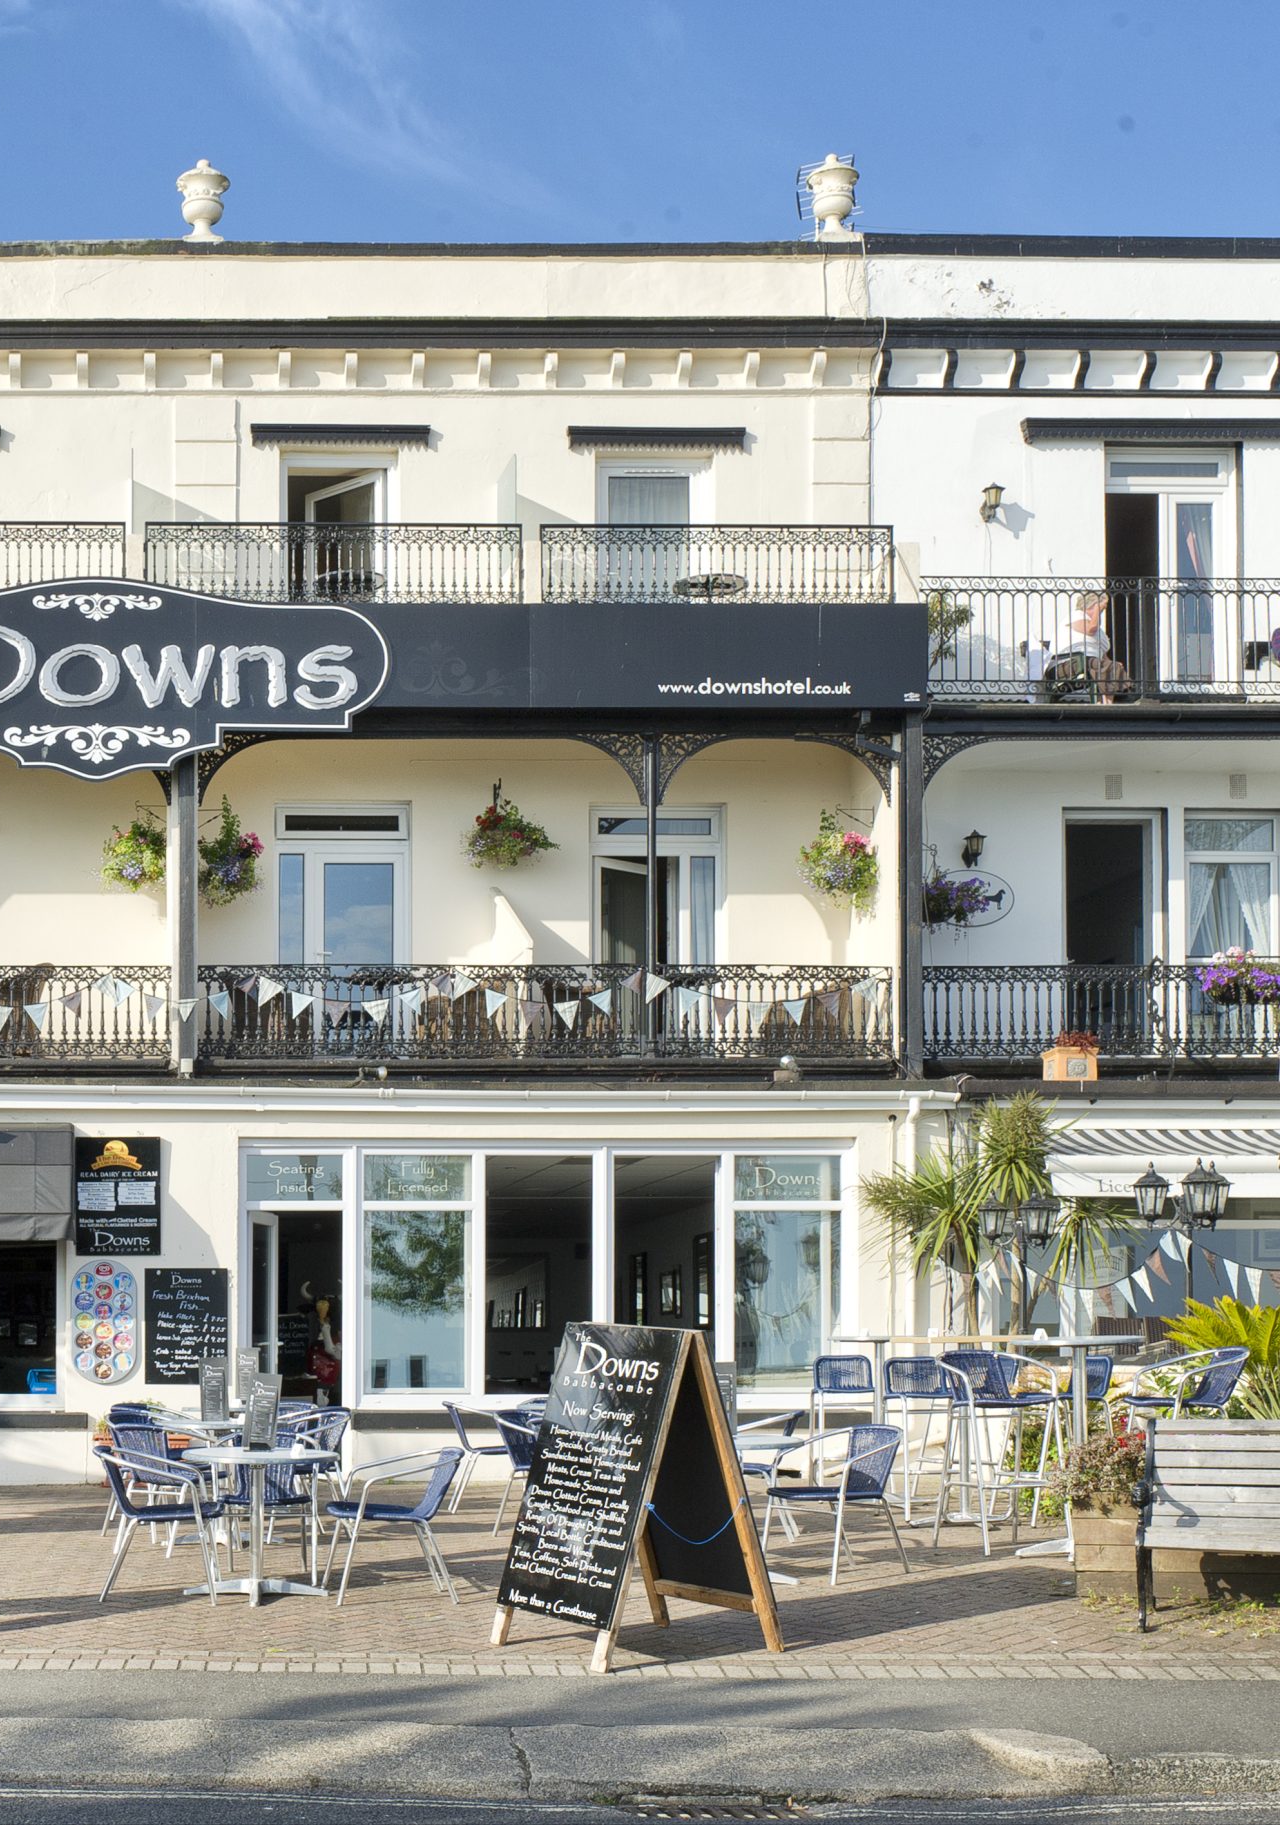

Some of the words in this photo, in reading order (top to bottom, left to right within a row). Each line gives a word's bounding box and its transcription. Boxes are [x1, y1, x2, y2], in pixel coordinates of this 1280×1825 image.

[657, 676, 852, 697] www.downshotel.co.uk
[267, 1160, 325, 1179] Seating
[400, 1160, 435, 1179] Fully
[754, 1166, 825, 1189] Downs
[275, 1179, 316, 1195] Inside
[387, 1178, 449, 1195] Licensed
[94, 1231, 151, 1247] Downs
[171, 1275, 202, 1285] Downs
[152, 1289, 174, 1300] Fresh
[175, 1289, 211, 1302] Brixham
[575, 1330, 592, 1343] The
[573, 1341, 661, 1381] Downs
[563, 1374, 654, 1396] Babbacombe
[561, 1399, 589, 1418] Now
[549, 1423, 600, 1440] Home-prepared
[584, 1441, 609, 1457] Crusty
[608, 1444, 633, 1458] Bread
[540, 1448, 579, 1463] Sandwiches
[579, 1454, 593, 1464] with
[592, 1455, 641, 1472] Home-cooked
[569, 1465, 592, 1478] Cream
[593, 1468, 612, 1480] Teas
[612, 1472, 627, 1483] with
[543, 1473, 581, 1489] Home-made
[581, 1480, 608, 1494] Scones
[608, 1485, 623, 1496] and
[526, 1496, 552, 1511] Caught
[551, 1501, 582, 1516] Seafood
[581, 1507, 595, 1518] and
[530, 1484, 552, 1497] Devon
[552, 1488, 580, 1502] Clotted
[603, 1497, 630, 1514] Locally
[525, 1509, 546, 1524] Range
[546, 1513, 558, 1525] Of
[557, 1515, 587, 1531] Draught
[586, 1520, 608, 1534] Beers
[608, 1526, 623, 1537] and
[537, 1537, 559, 1551] Beers
[558, 1543, 572, 1554] and
[540, 1525, 560, 1538] Local
[559, 1528, 582, 1541] Bottle
[582, 1533, 627, 1552] Conditioned
[509, 1557, 529, 1570] Local
[528, 1561, 555, 1577] Clotted
[554, 1567, 577, 1581] Cream
[576, 1572, 588, 1584] Ice
[588, 1575, 613, 1590] Cream
[560, 1556, 580, 1569] Soft
[578, 1559, 602, 1574] Drinks
[602, 1566, 617, 1577] and
[508, 1588, 529, 1604] More
[529, 1593, 545, 1608] than
[545, 1601, 551, 1610] a
[552, 1599, 598, 1621] Guesthouse
